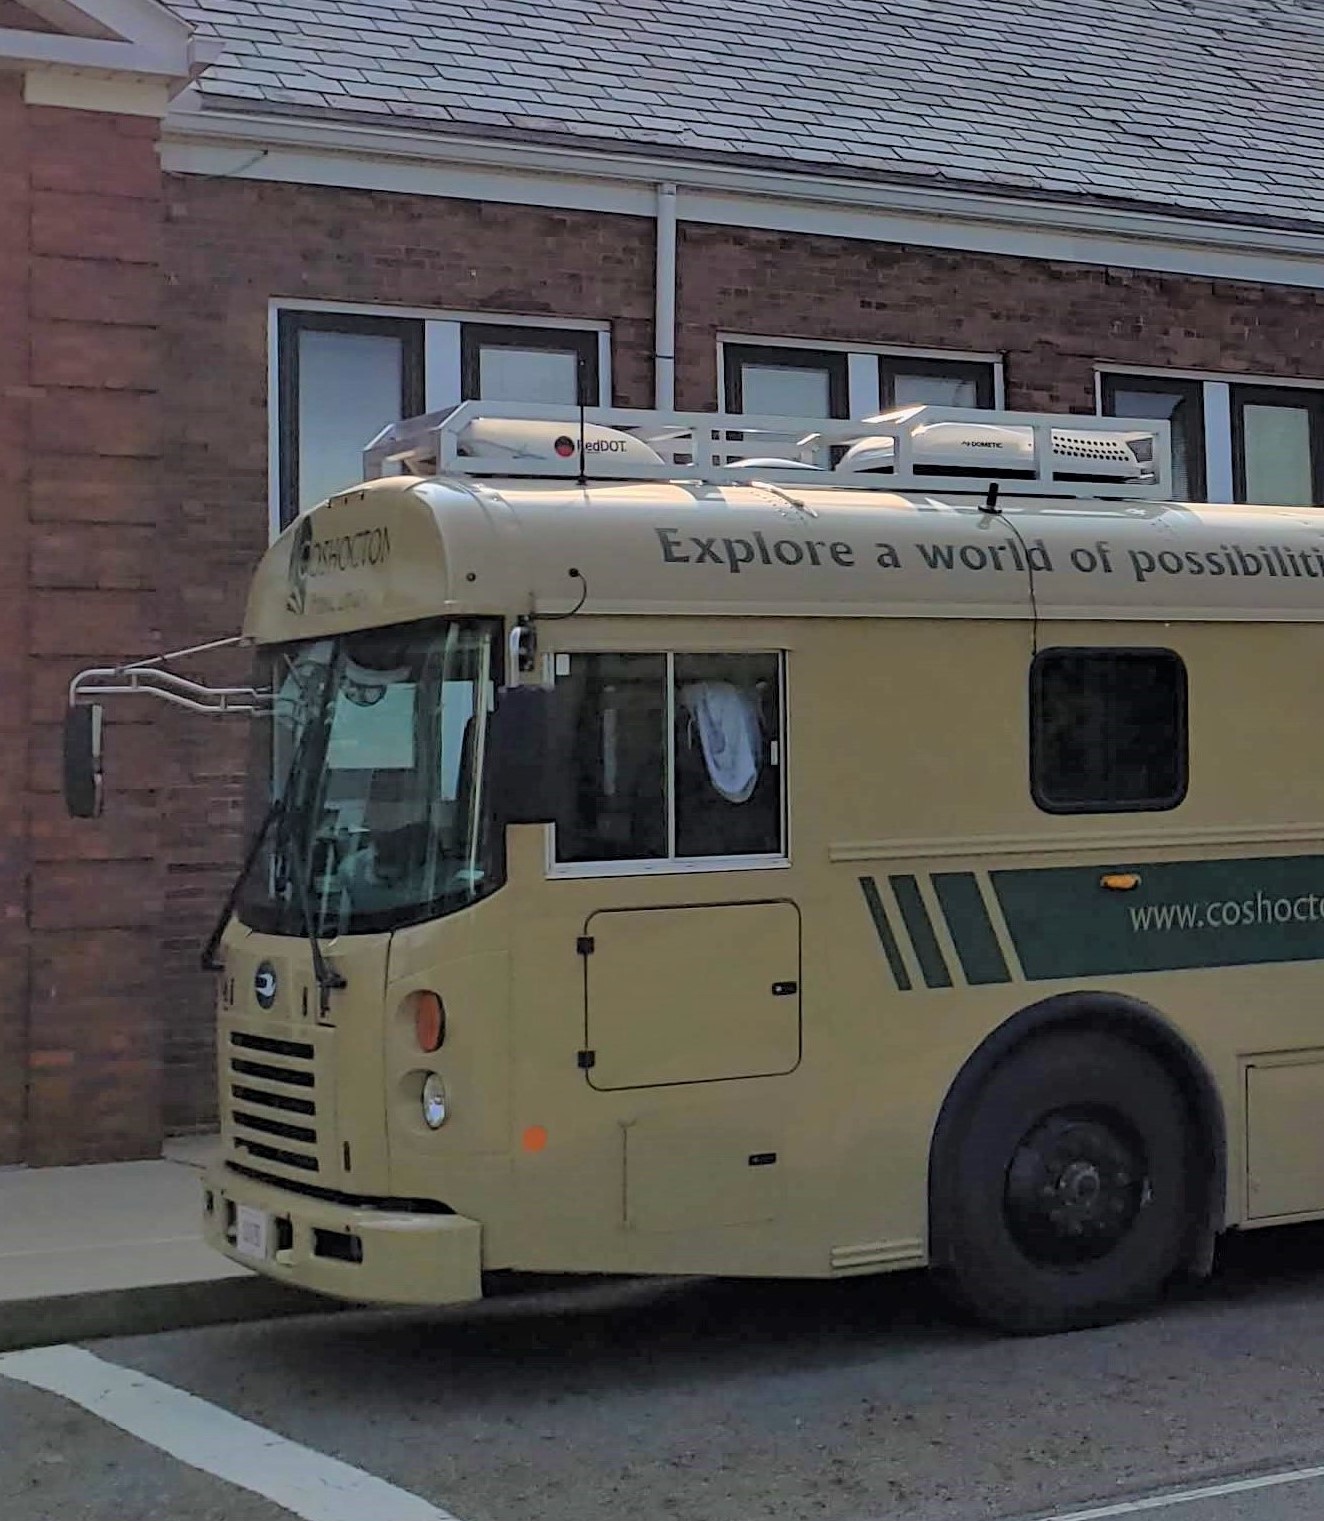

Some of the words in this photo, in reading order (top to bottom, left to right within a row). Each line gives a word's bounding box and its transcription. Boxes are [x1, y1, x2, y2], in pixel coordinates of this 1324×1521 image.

[655, 528, 855, 573] Explore
[875, 543, 901, 568] a
[915, 538, 1053, 572] world
[1070, 541, 1113, 573] of
